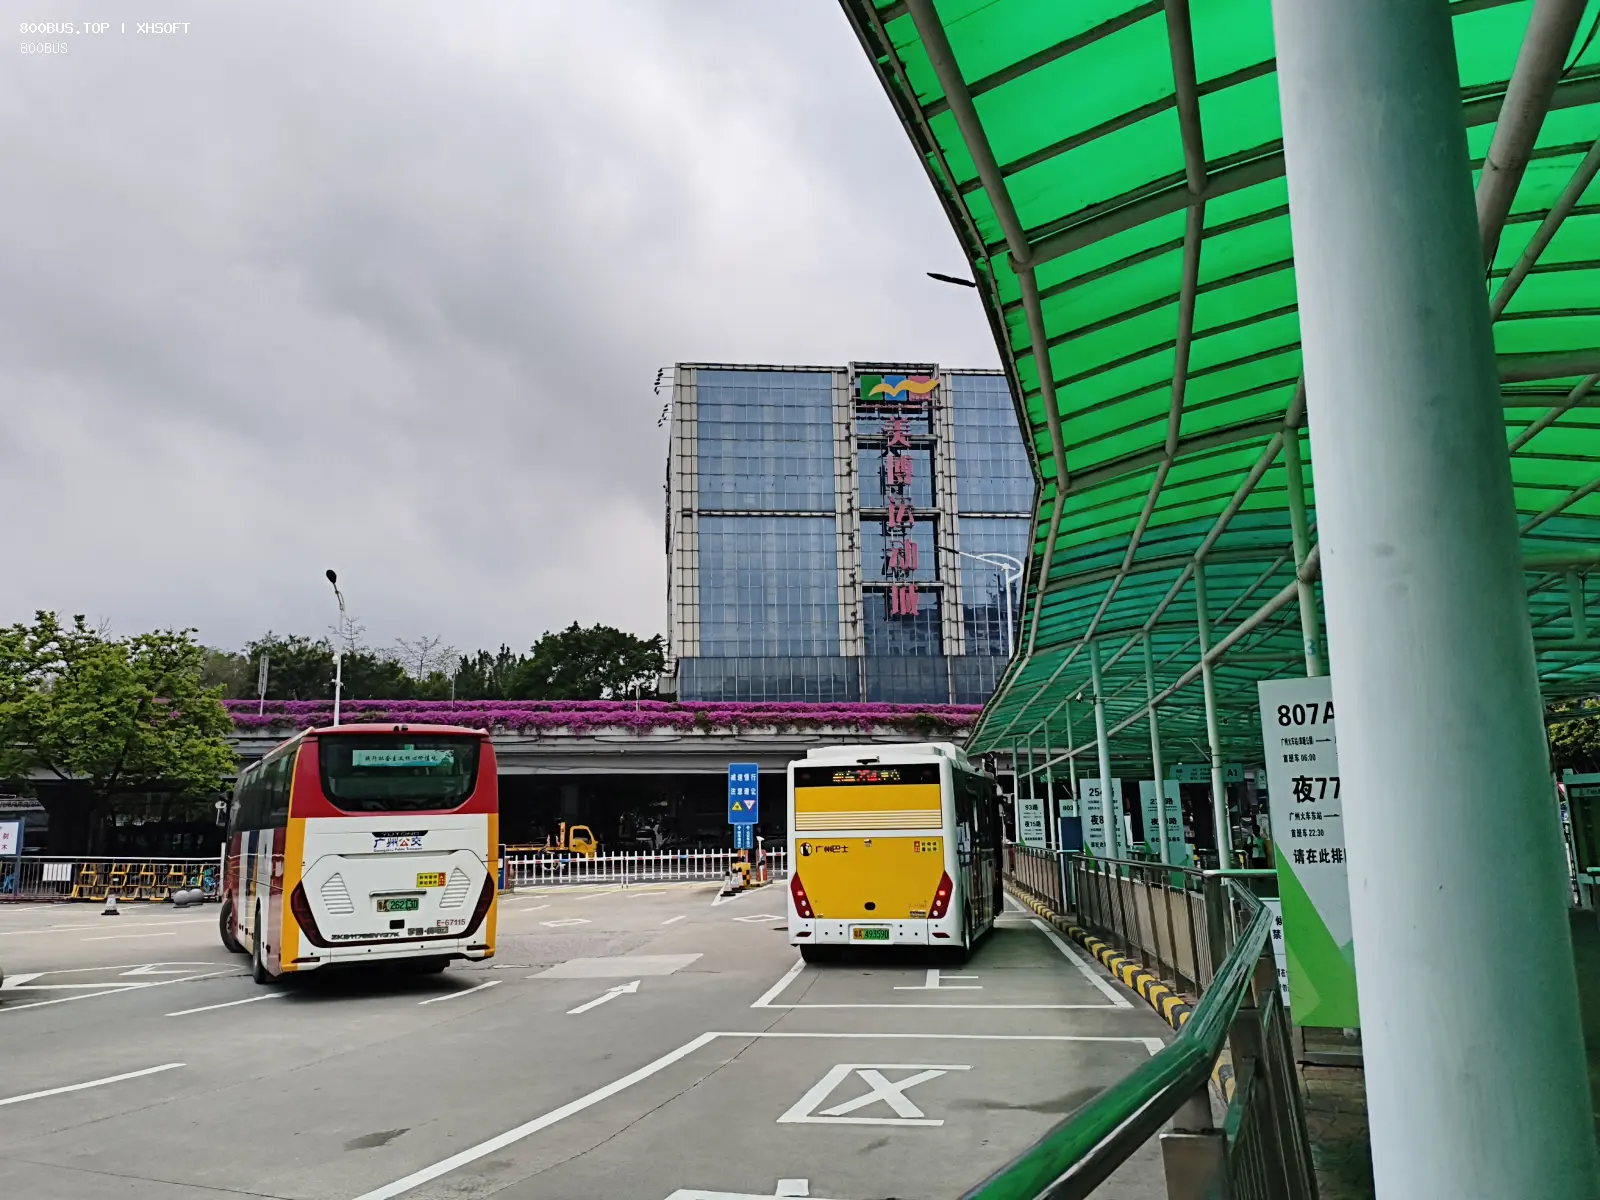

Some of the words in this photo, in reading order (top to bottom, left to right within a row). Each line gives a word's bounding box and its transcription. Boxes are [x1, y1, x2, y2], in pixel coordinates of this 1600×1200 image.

[1227, 768, 1238, 777] A1
[1289, 811, 1323, 822] 广州火车东站
[373, 836, 422, 849] 广州公交
[815, 844, 849, 854] 广州巴士
[1293, 848, 1347, 865] 请在此排
[436, 919, 466, 927] E-67115
